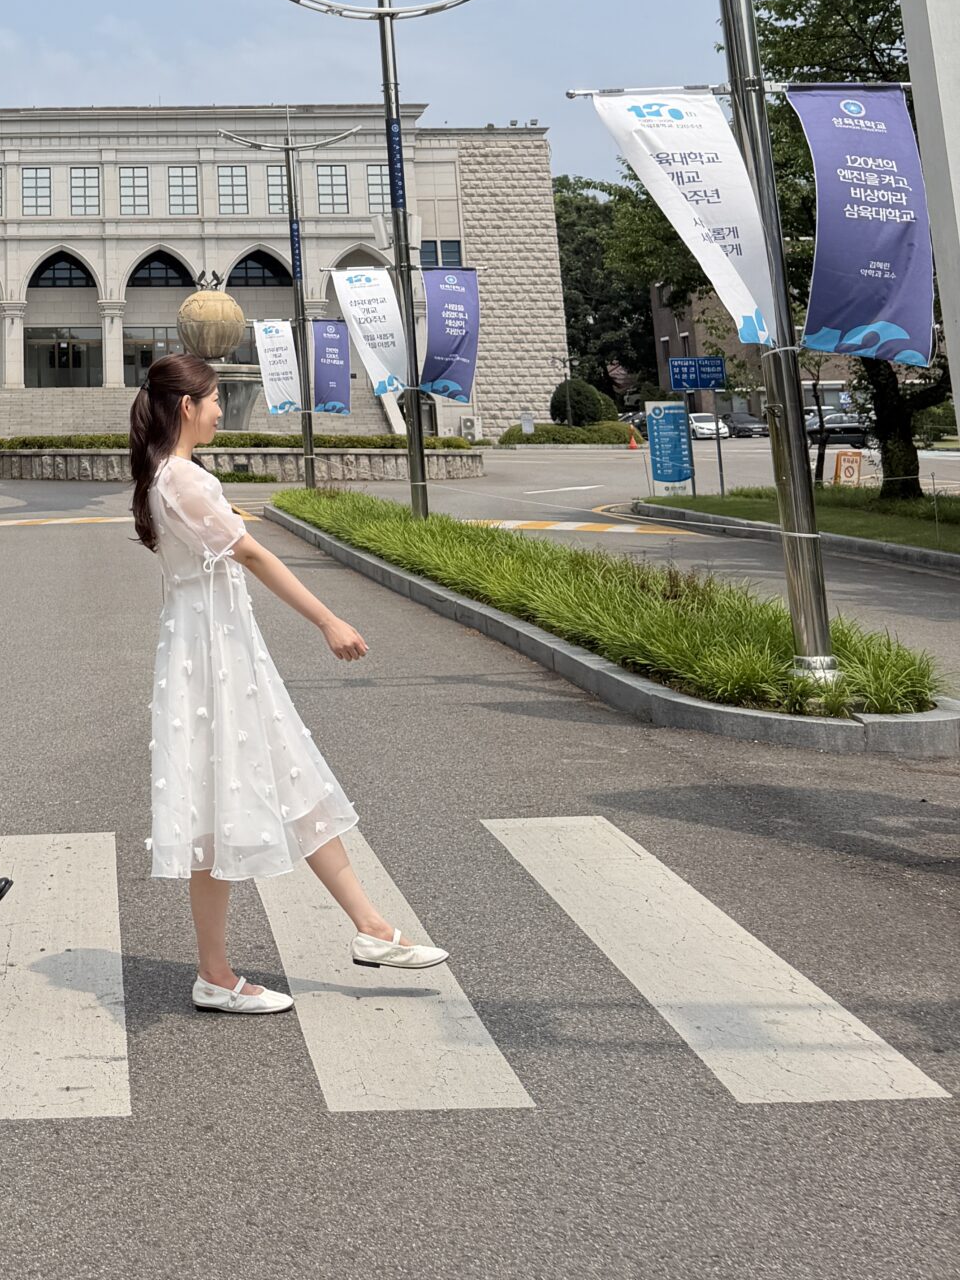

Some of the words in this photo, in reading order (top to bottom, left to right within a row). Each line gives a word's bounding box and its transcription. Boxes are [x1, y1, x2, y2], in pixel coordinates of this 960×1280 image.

[832, 117, 887, 130] 삼육대학교
[649, 151, 722, 166] 육대학교
[845, 154, 898, 172] 120년의
[836, 168, 880, 186] 엔진을
[850, 187, 908, 206] 비상하라
[843, 203, 916, 223] 삼육대학교
[883, 270, 897, 279] 교수
